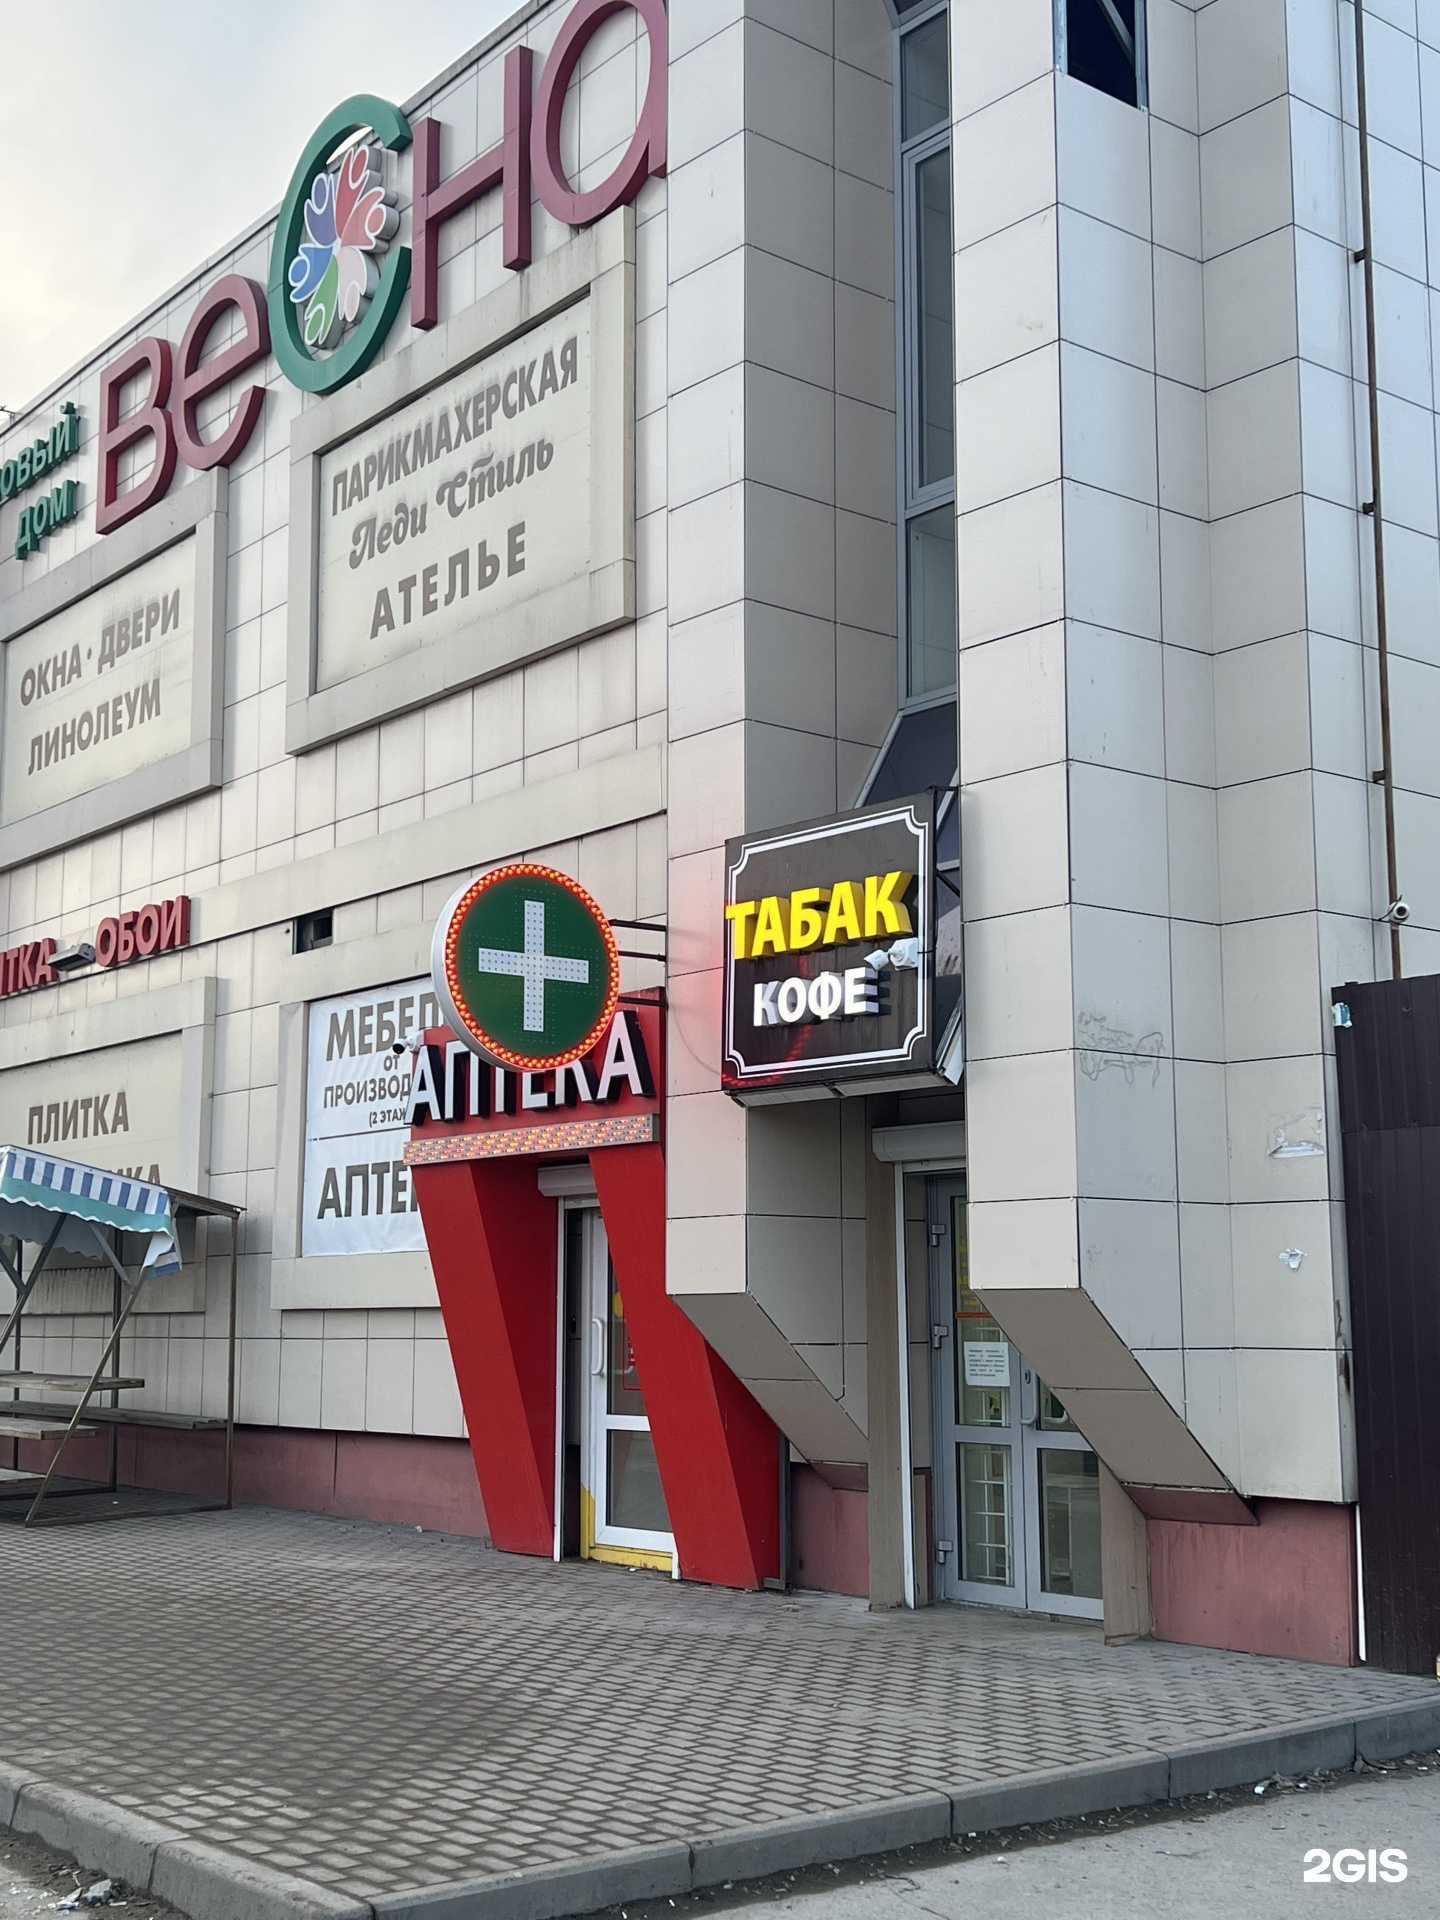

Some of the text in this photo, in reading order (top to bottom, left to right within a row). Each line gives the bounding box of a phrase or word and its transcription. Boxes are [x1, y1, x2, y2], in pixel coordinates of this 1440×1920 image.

[332, 335, 579, 517] ПАРИКМАХЕРСКАЯ
[16, 480, 79, 560] ДОМ
[349, 438, 554, 570] Леди Стиль
[369, 521, 527, 640] АТЕЛЬЕ
[20, 587, 181, 707] ОКНА ДВЕРИ
[27, 678, 161, 777] ЛИНОЛЕУМ
[95, 895, 191, 968] ОБОИ
[725, 870, 913, 961] ТАБАК
[326, 991, 447, 1061] МЕБЕЛ
[753, 966, 880, 1028] КОФЕ
[27, 1091, 129, 1145] ПЛИТКА
